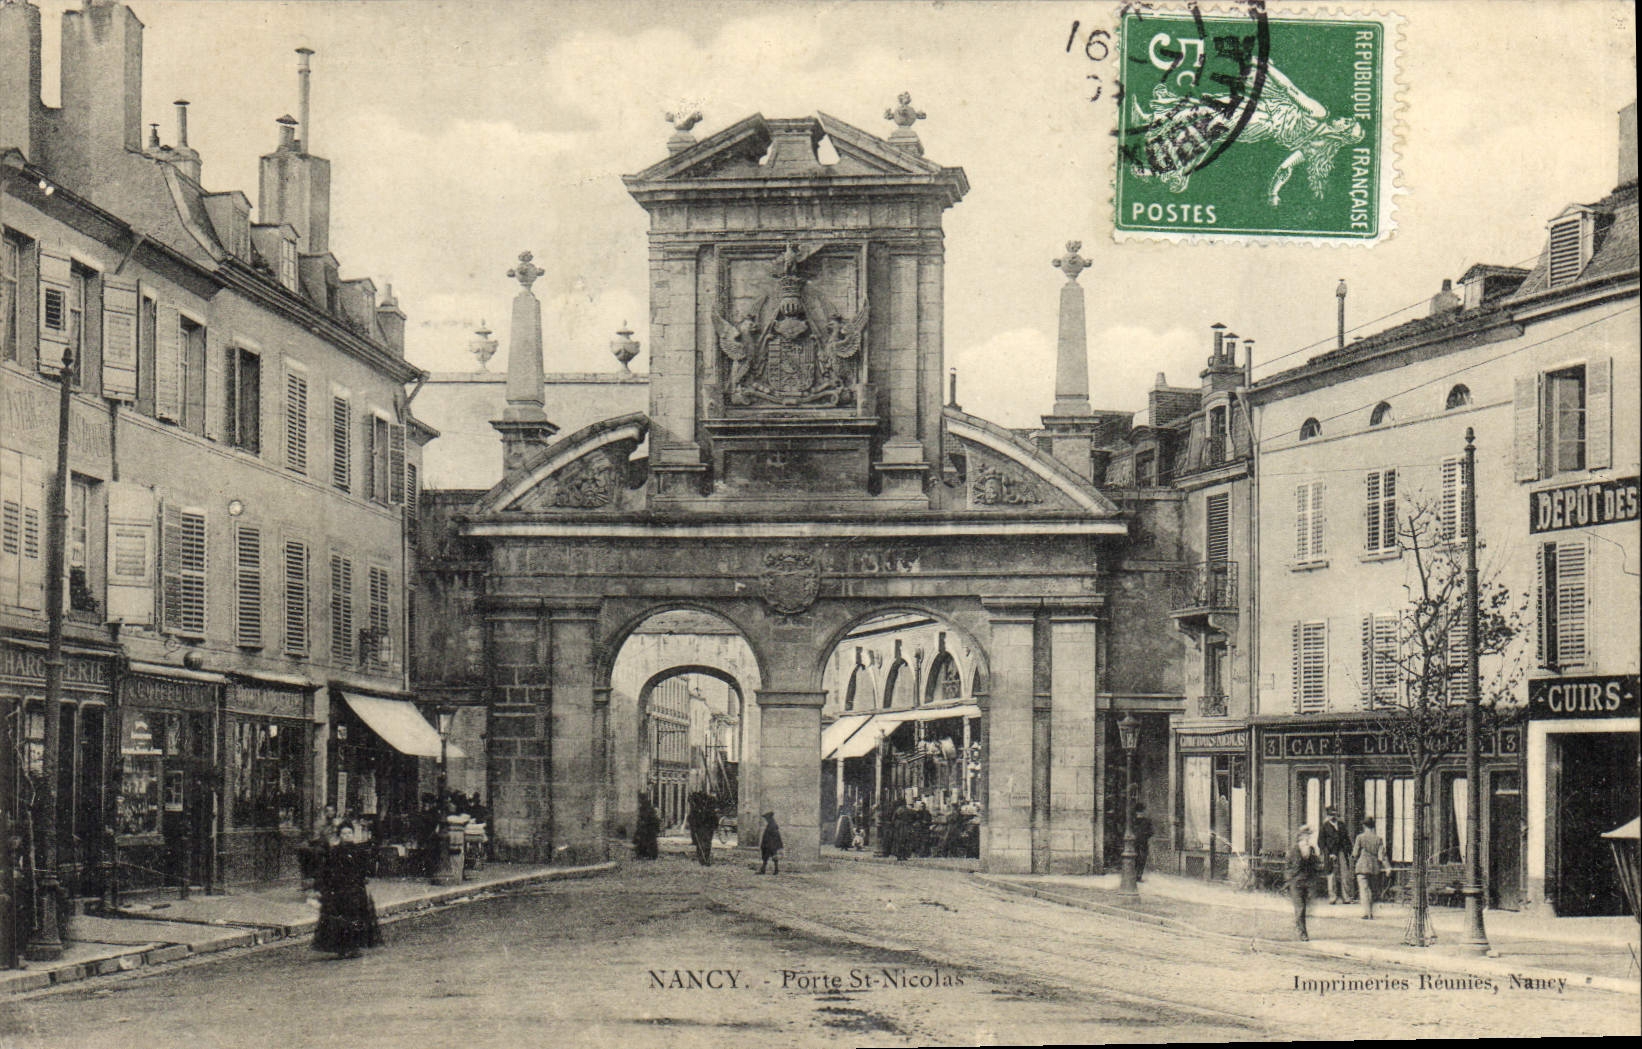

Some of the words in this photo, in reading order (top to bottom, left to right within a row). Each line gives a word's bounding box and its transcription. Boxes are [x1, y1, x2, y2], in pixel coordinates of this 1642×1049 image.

[1350, 147, 1370, 230] FRANÇAISE
[1131, 202, 1217, 224] POSTES
[1604, 486, 1638, 520] DES
[1549, 681, 1621, 712] CUIRS
